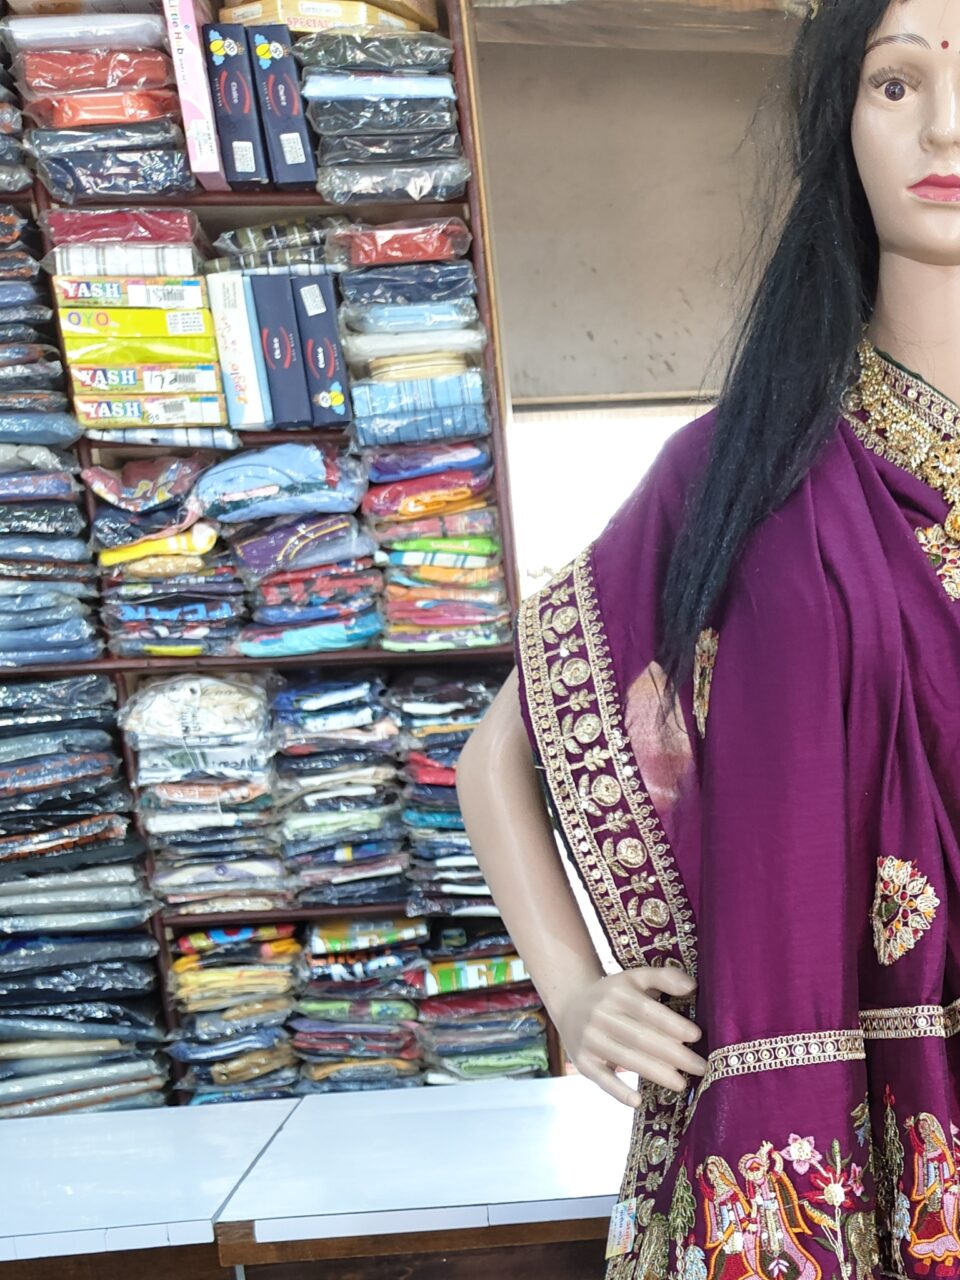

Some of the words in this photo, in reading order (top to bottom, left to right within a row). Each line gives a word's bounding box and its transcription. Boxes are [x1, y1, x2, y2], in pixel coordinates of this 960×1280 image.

[287, 17, 329, 28] SPECIAL
[64, 281, 121, 299] YASH
[67, 311, 109, 326] OYO
[79, 368, 137, 386] YASH
[84, 401, 142, 418] YASH
